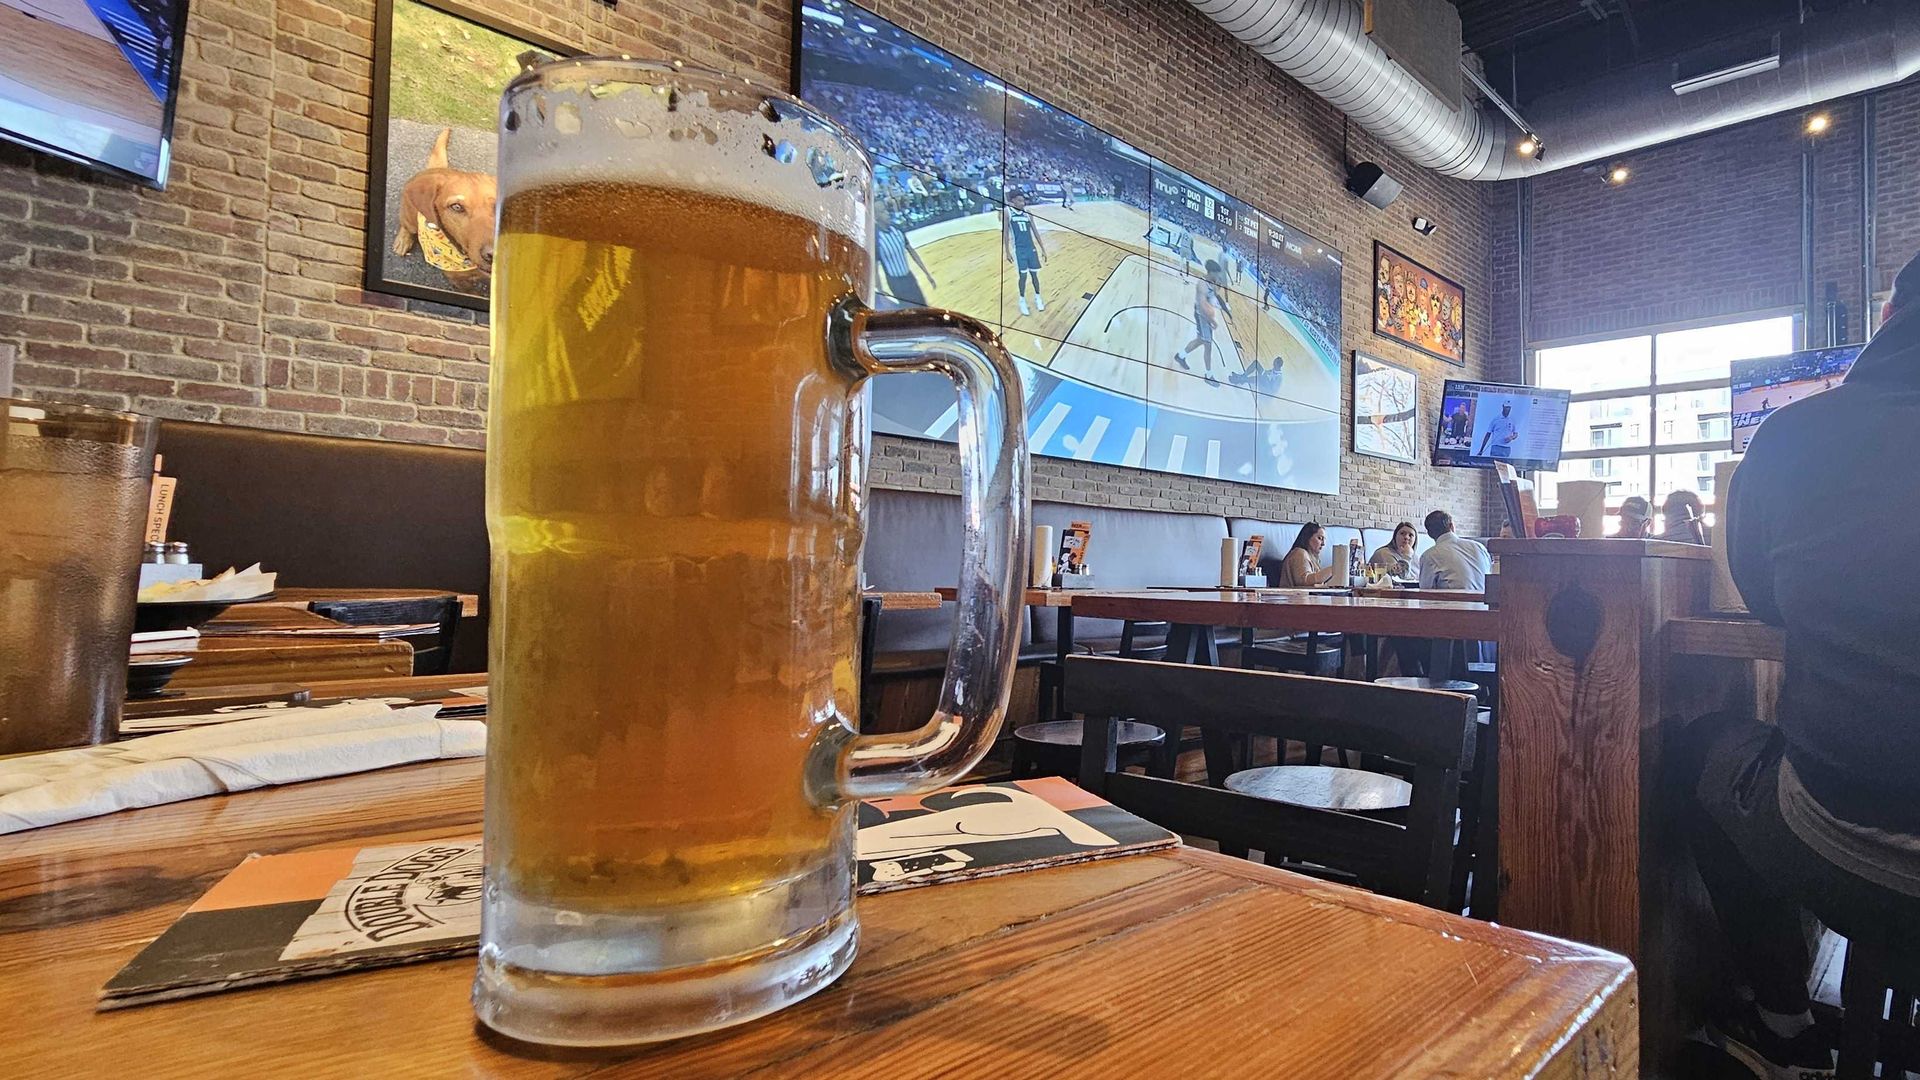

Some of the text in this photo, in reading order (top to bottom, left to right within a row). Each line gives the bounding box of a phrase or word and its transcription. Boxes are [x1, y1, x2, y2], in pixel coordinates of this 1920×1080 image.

[1018, 222, 1027, 231] 11
[156, 484, 169, 514] LUNCH
[354, 846, 467, 942] DOUBLE DOGS
